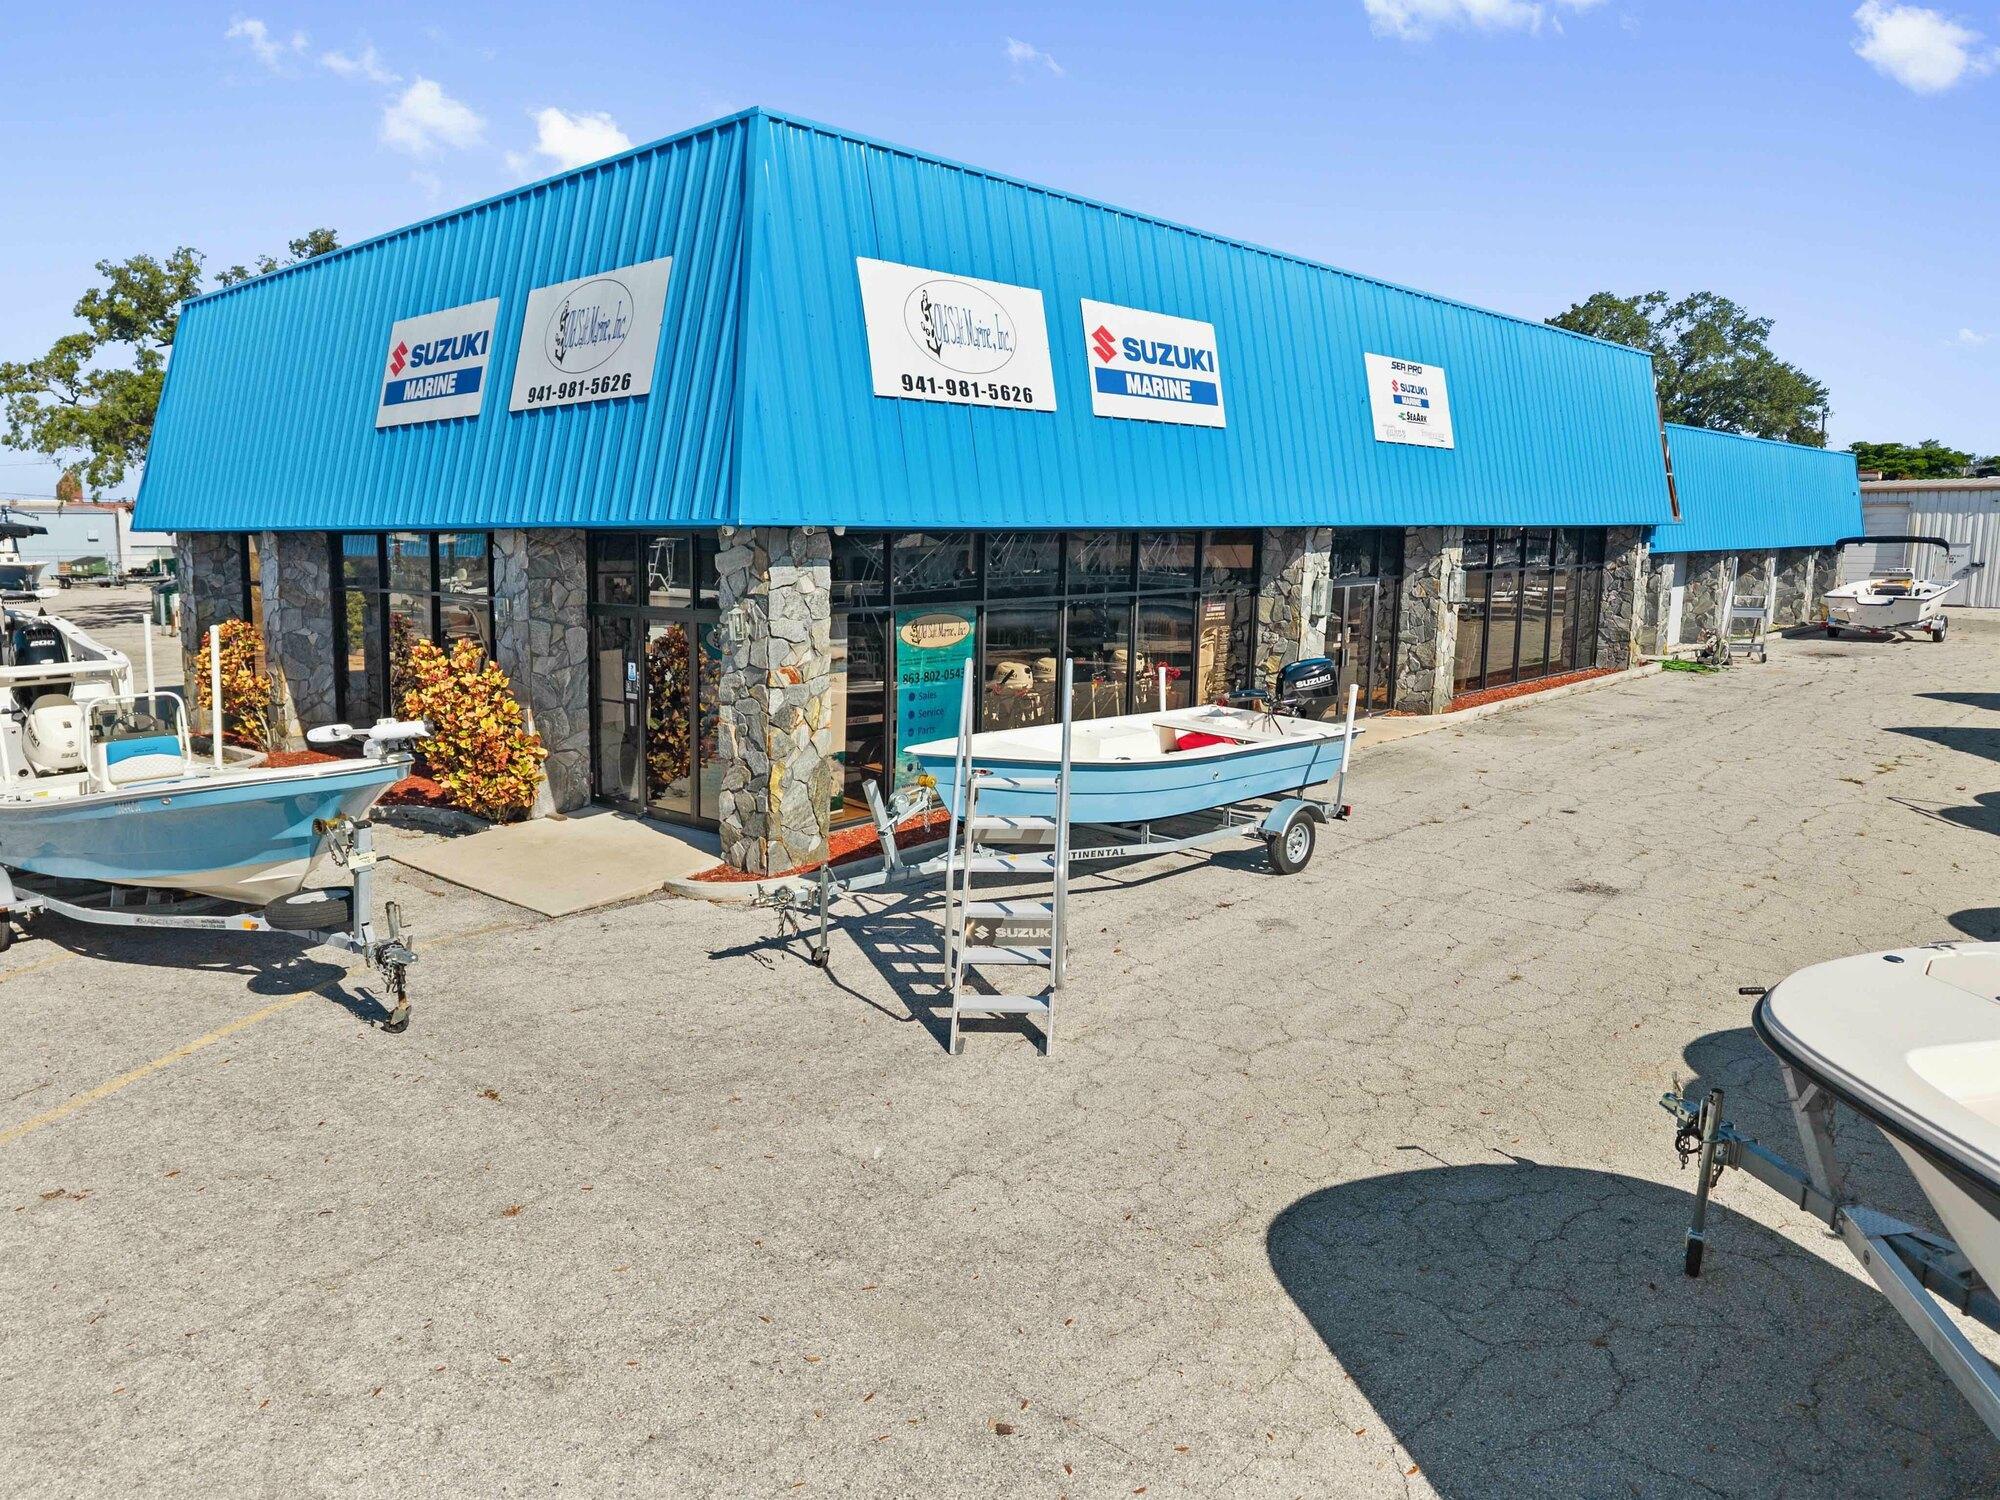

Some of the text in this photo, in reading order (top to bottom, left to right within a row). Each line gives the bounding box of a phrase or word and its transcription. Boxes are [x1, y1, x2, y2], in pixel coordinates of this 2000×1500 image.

[995, 313, 1012, 352] Inc.
[409, 330, 490, 369] SUZUKI
[1121, 336, 1215, 373] SUZUKI
[1391, 361, 1423, 375] SEA PRO
[402, 372, 457, 401] MARINE
[527, 371, 632, 403] 941-981-5626
[900, 373, 1034, 404] 941-981-5626
[1124, 373, 1193, 401] MARINE
[1400, 383, 1428, 396] SUZUKI
[1295, 673, 1332, 688] SUZUKI
[918, 691, 937, 701] Sales
[918, 708, 945, 719] Service
[917, 727, 936, 736] Parts
[1047, 848, 1127, 861] CTINENTAL
[995, 927, 1052, 938] SUZUK
